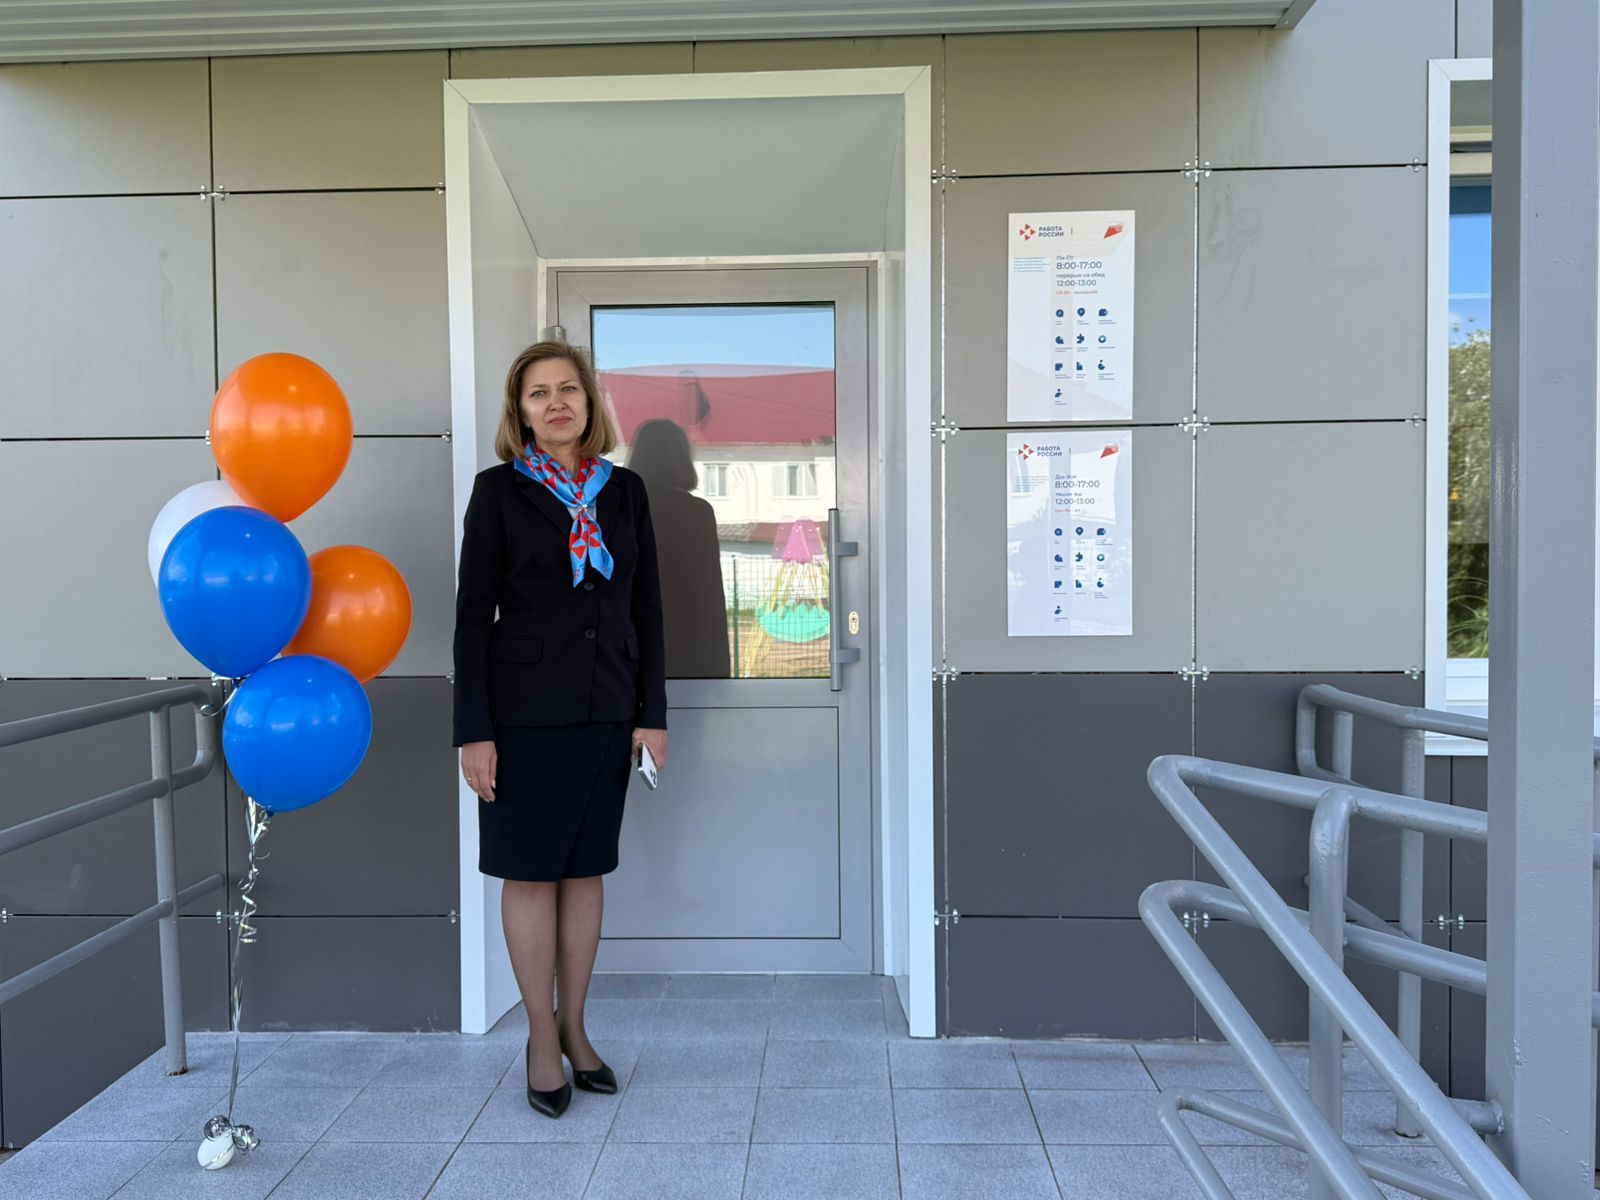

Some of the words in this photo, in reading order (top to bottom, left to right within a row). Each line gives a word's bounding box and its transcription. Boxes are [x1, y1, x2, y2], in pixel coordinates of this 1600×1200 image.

[1056, 261, 1102, 270] 8:00-17:00
[1056, 279, 1097, 287] 12:00-13:00
[1055, 480, 1100, 488] 8:00-17:00
